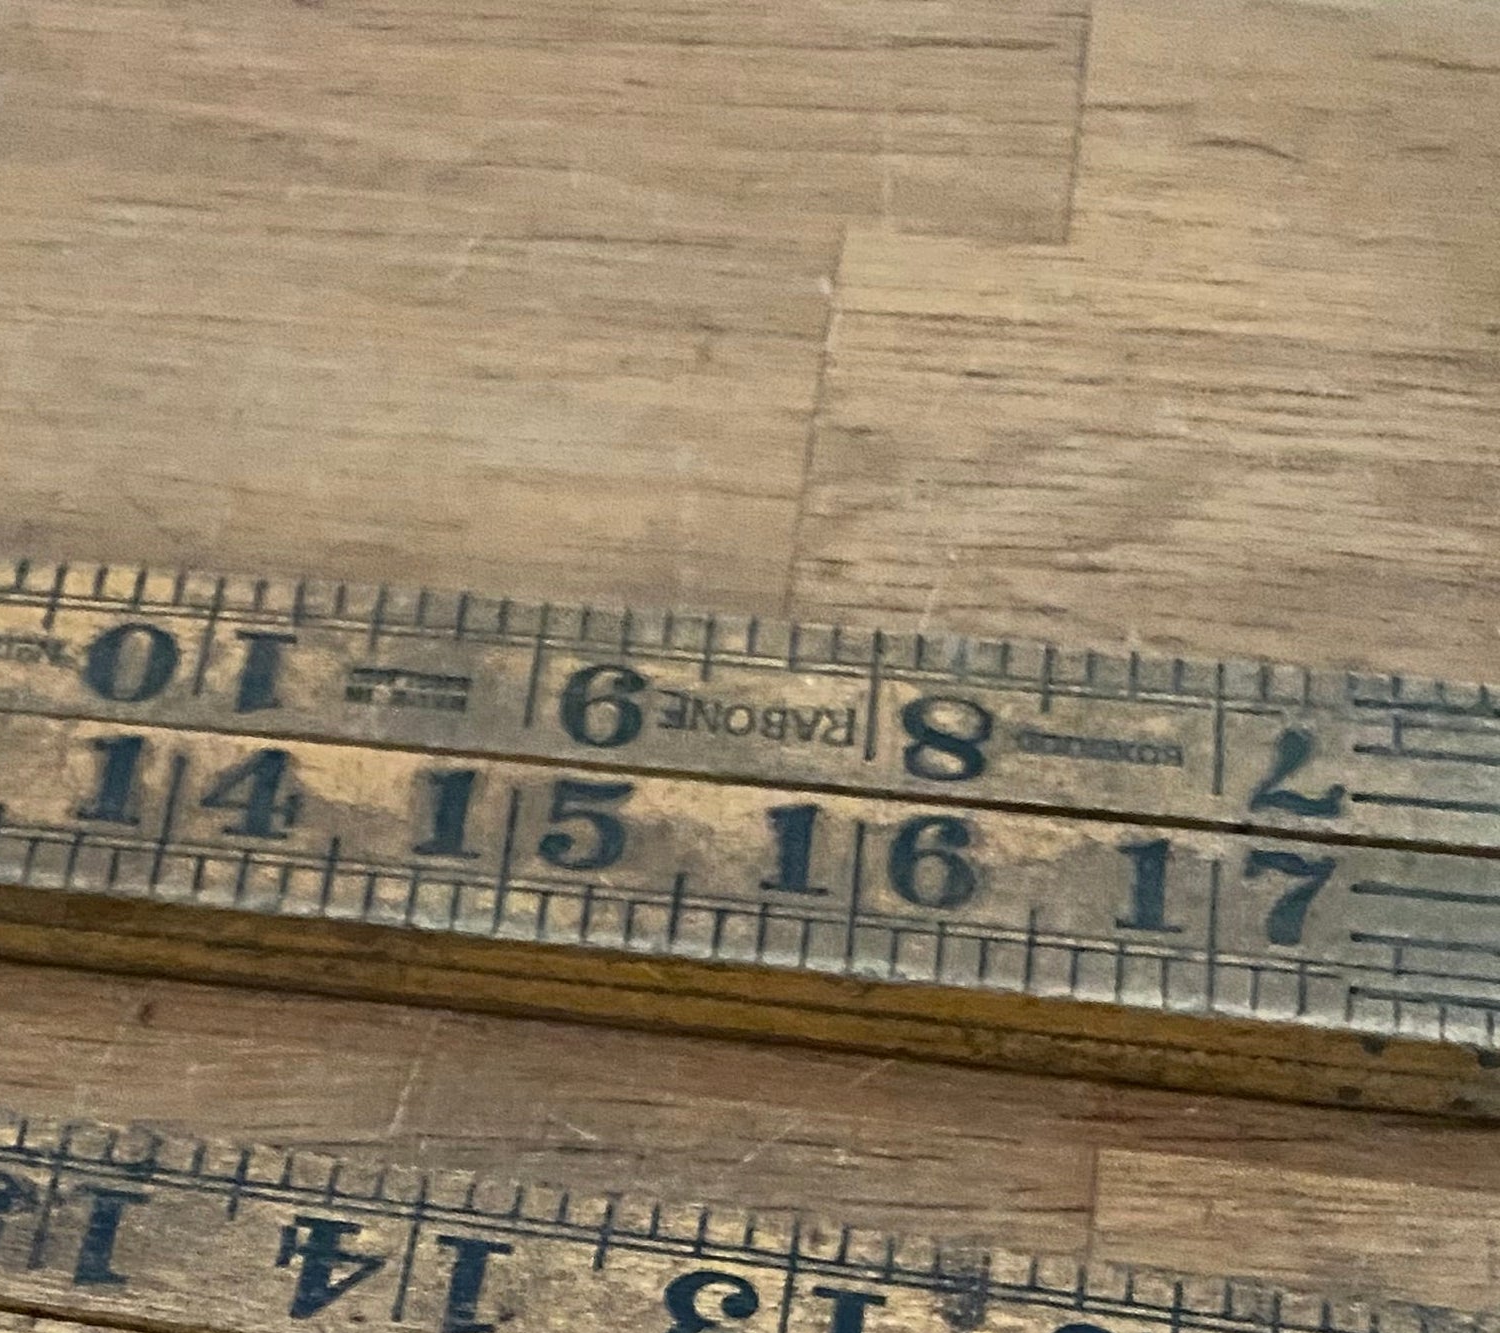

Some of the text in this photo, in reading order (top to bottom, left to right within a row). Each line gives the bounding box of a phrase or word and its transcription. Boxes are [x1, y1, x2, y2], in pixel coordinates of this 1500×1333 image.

[86, 621, 297, 714] 10
[657, 688, 858, 748] RABONE
[903, 694, 994, 781] 8
[76, 735, 305, 840] 14
[412, 768, 636, 870] 15
[1249, 726, 1349, 817] 7
[761, 803, 979, 910] 16
[1115, 839, 1336, 944] 17
